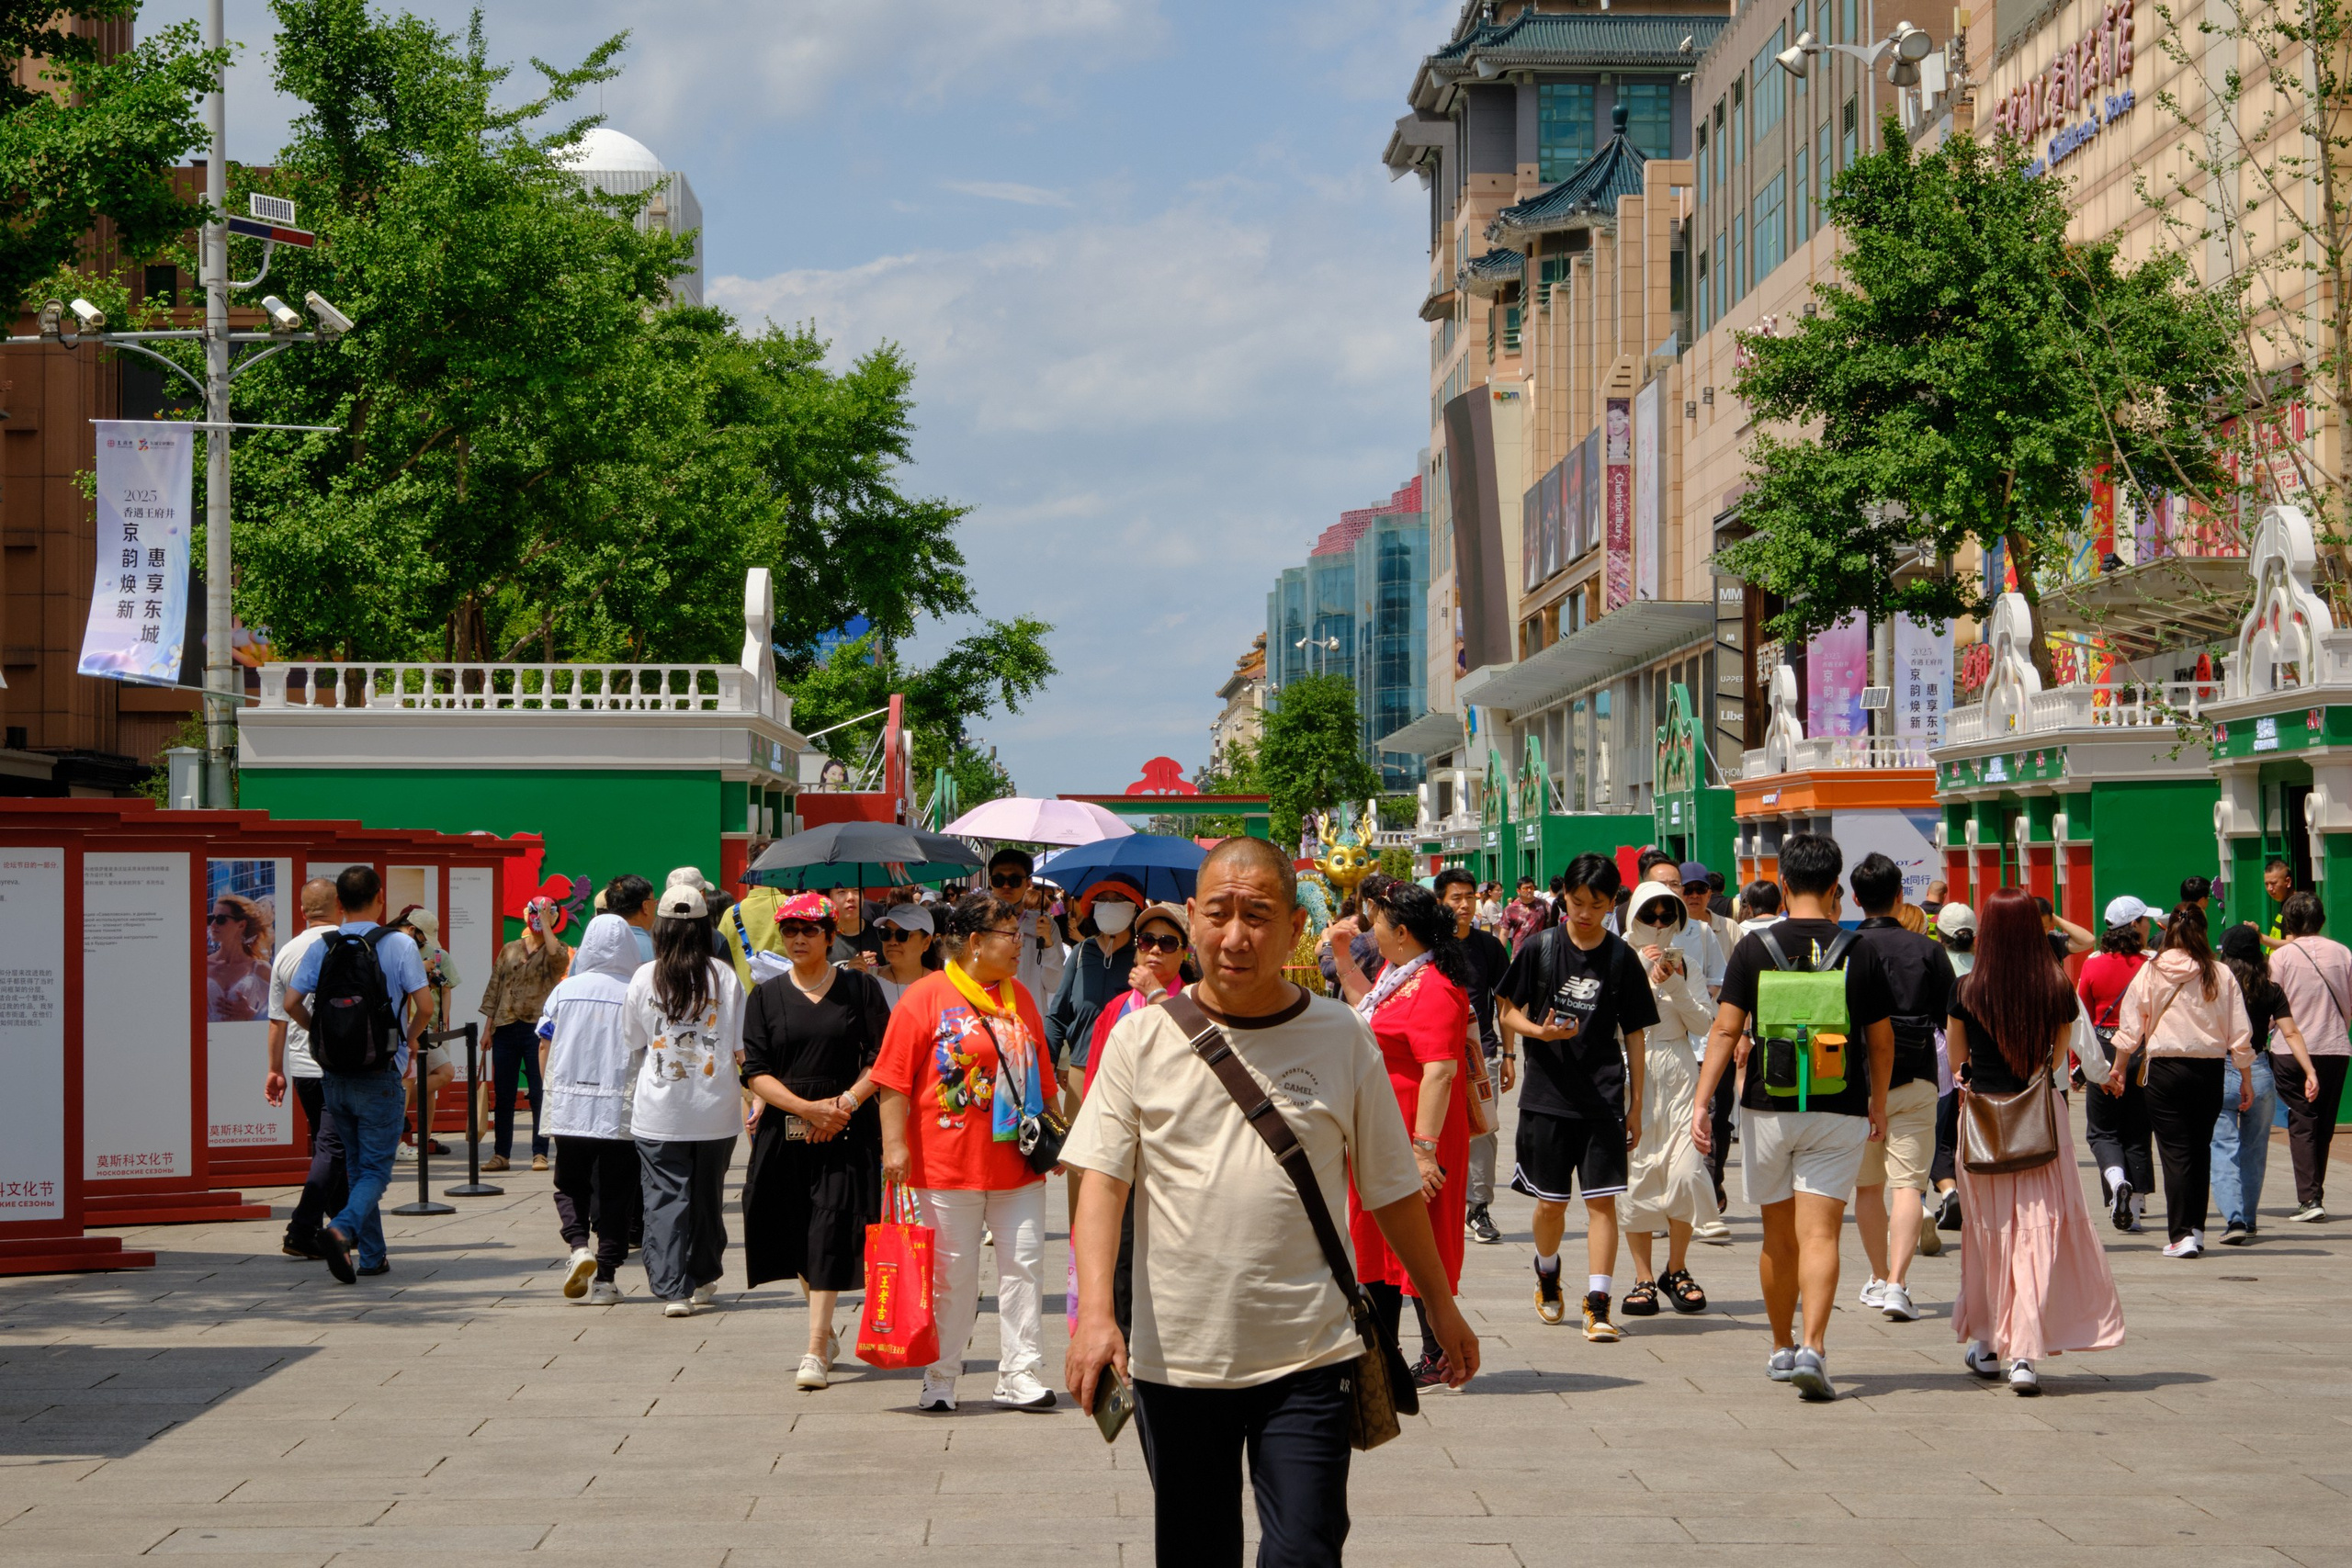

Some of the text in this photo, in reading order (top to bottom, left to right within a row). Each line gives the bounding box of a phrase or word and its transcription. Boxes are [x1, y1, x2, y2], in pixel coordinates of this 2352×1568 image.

[2105, 88, 2135, 124] Store
[1493, 391, 1520, 402] apm
[124, 490, 157, 502] 2025
[1613, 473, 1624, 540] Charlotte Tilbury
[116, 523, 139, 619] 京韵焕新
[140, 547, 165, 644] 惠享东城
[1911, 648, 1932, 656] 2025
[1823, 669, 1834, 731] 京韵焕新
[1910, 669, 1921, 729] 京韵焕新
[1566, 998, 1598, 1011] balanc
[1283, 1082, 1314, 1096] CAMEL
[209, 1122, 277, 1136] 莫斯科文化节
[96, 1152, 175, 1168] 莫斯科文化节
[876, 1274, 890, 1321] 王老吉
